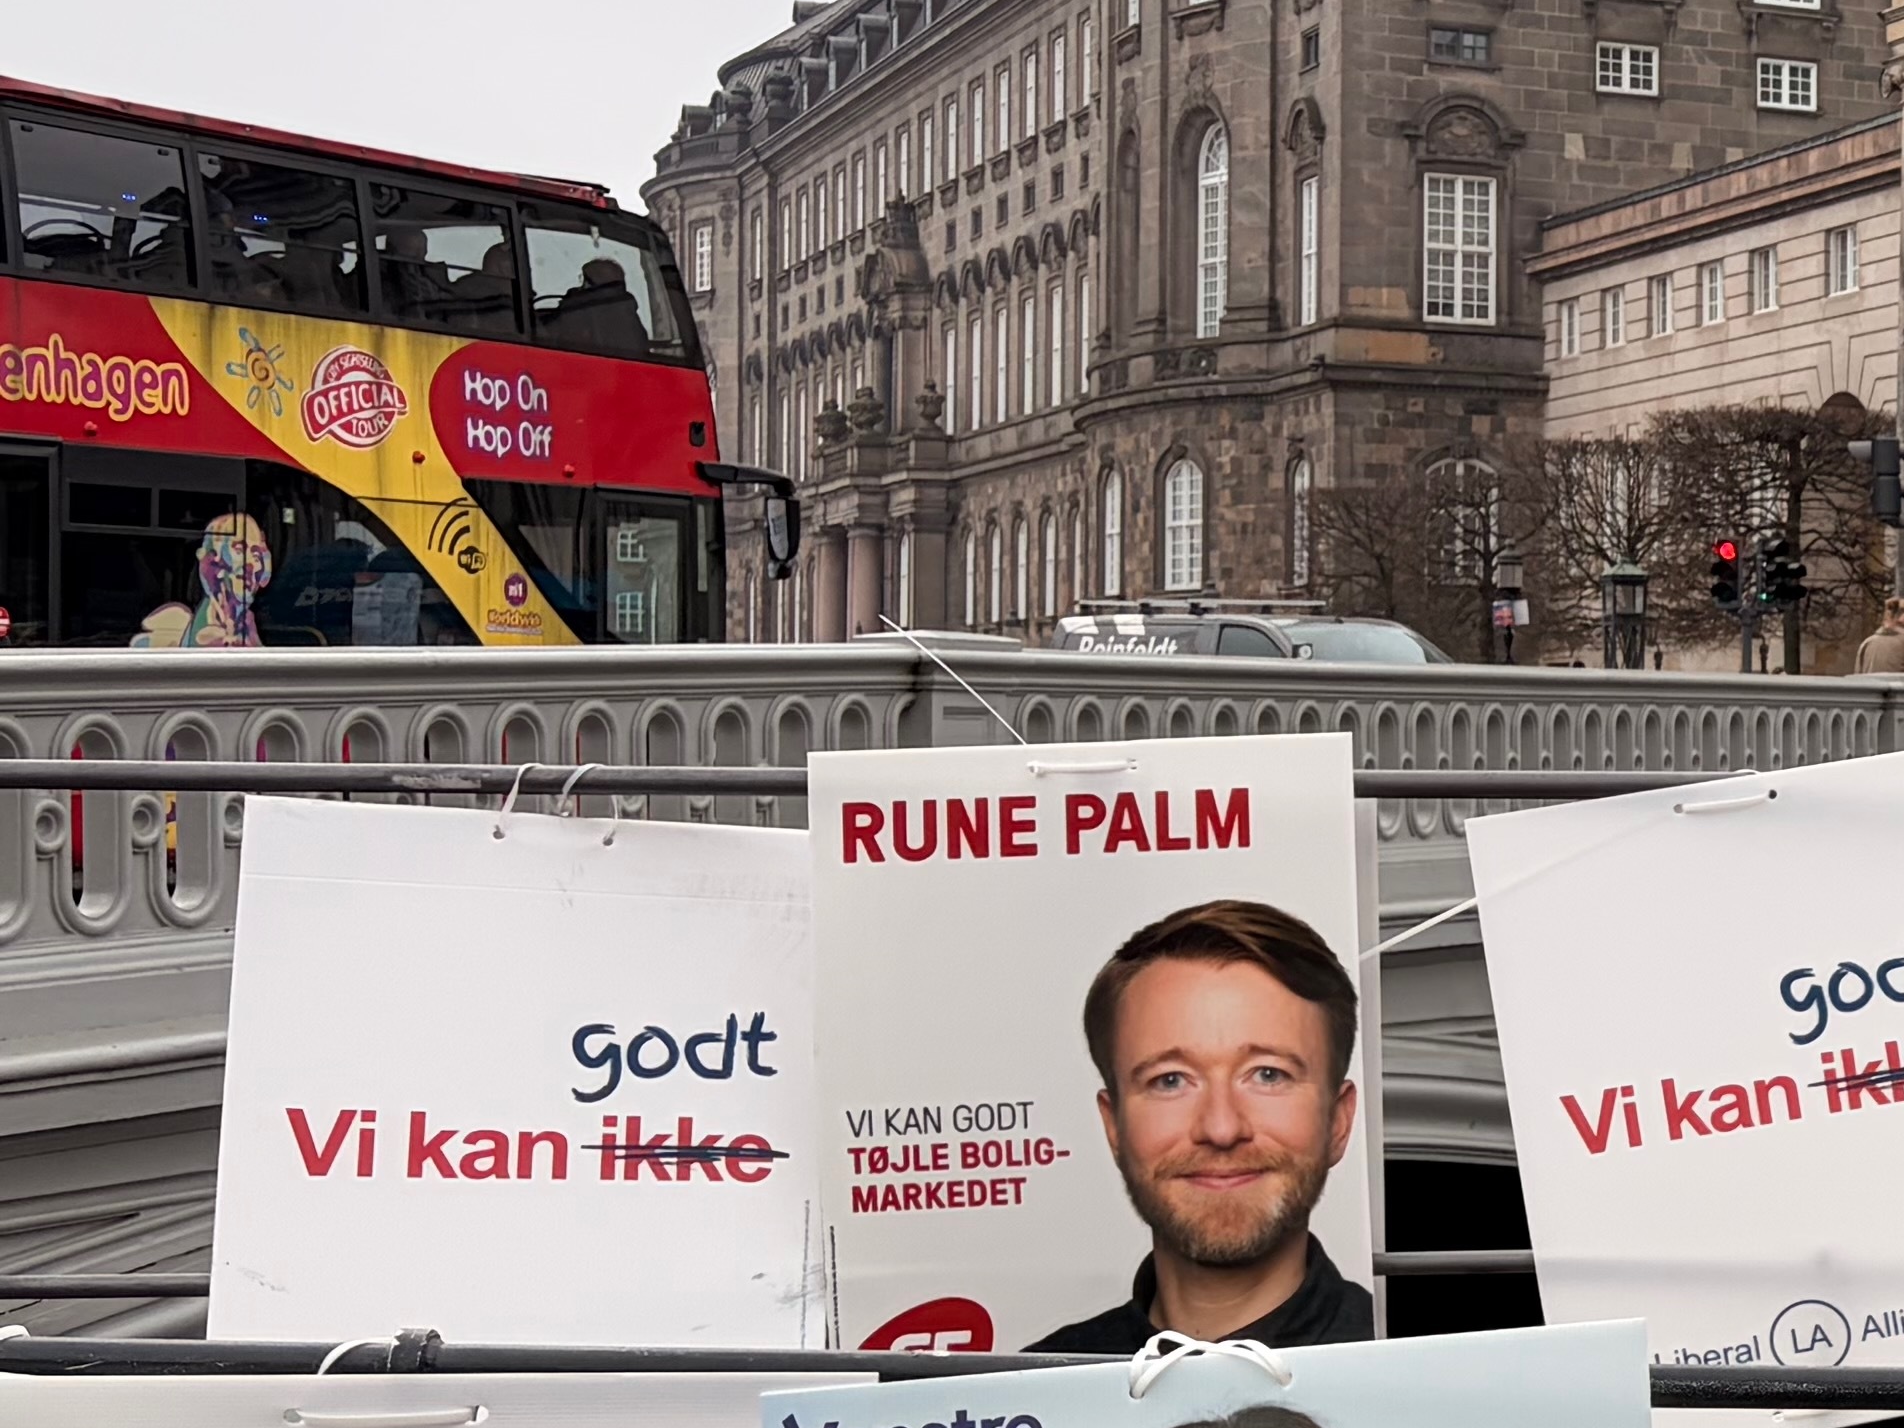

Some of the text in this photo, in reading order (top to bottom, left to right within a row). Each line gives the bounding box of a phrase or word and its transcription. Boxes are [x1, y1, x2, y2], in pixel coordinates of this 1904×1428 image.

[313, 384, 404, 425] OFFICIAL
[464, 370, 547, 412] Hop On
[351, 413, 389, 437] TOUR
[467, 417, 552, 458] Hop Off
[843, 789, 1251, 864] RUNE PALM
[572, 1012, 777, 1103] godt
[846, 1101, 1034, 1138] VI KAN GODT
[1561, 1086, 1642, 1154] Vi
[1662, 1076, 1802, 1140] kan
[287, 1108, 770, 1183] Vi kan ikke
[849, 1139, 1070, 1174] TØJLE BOLIG-
[852, 1178, 1024, 1212] MARKEDET
[1791, 1324, 1833, 1354] LA
